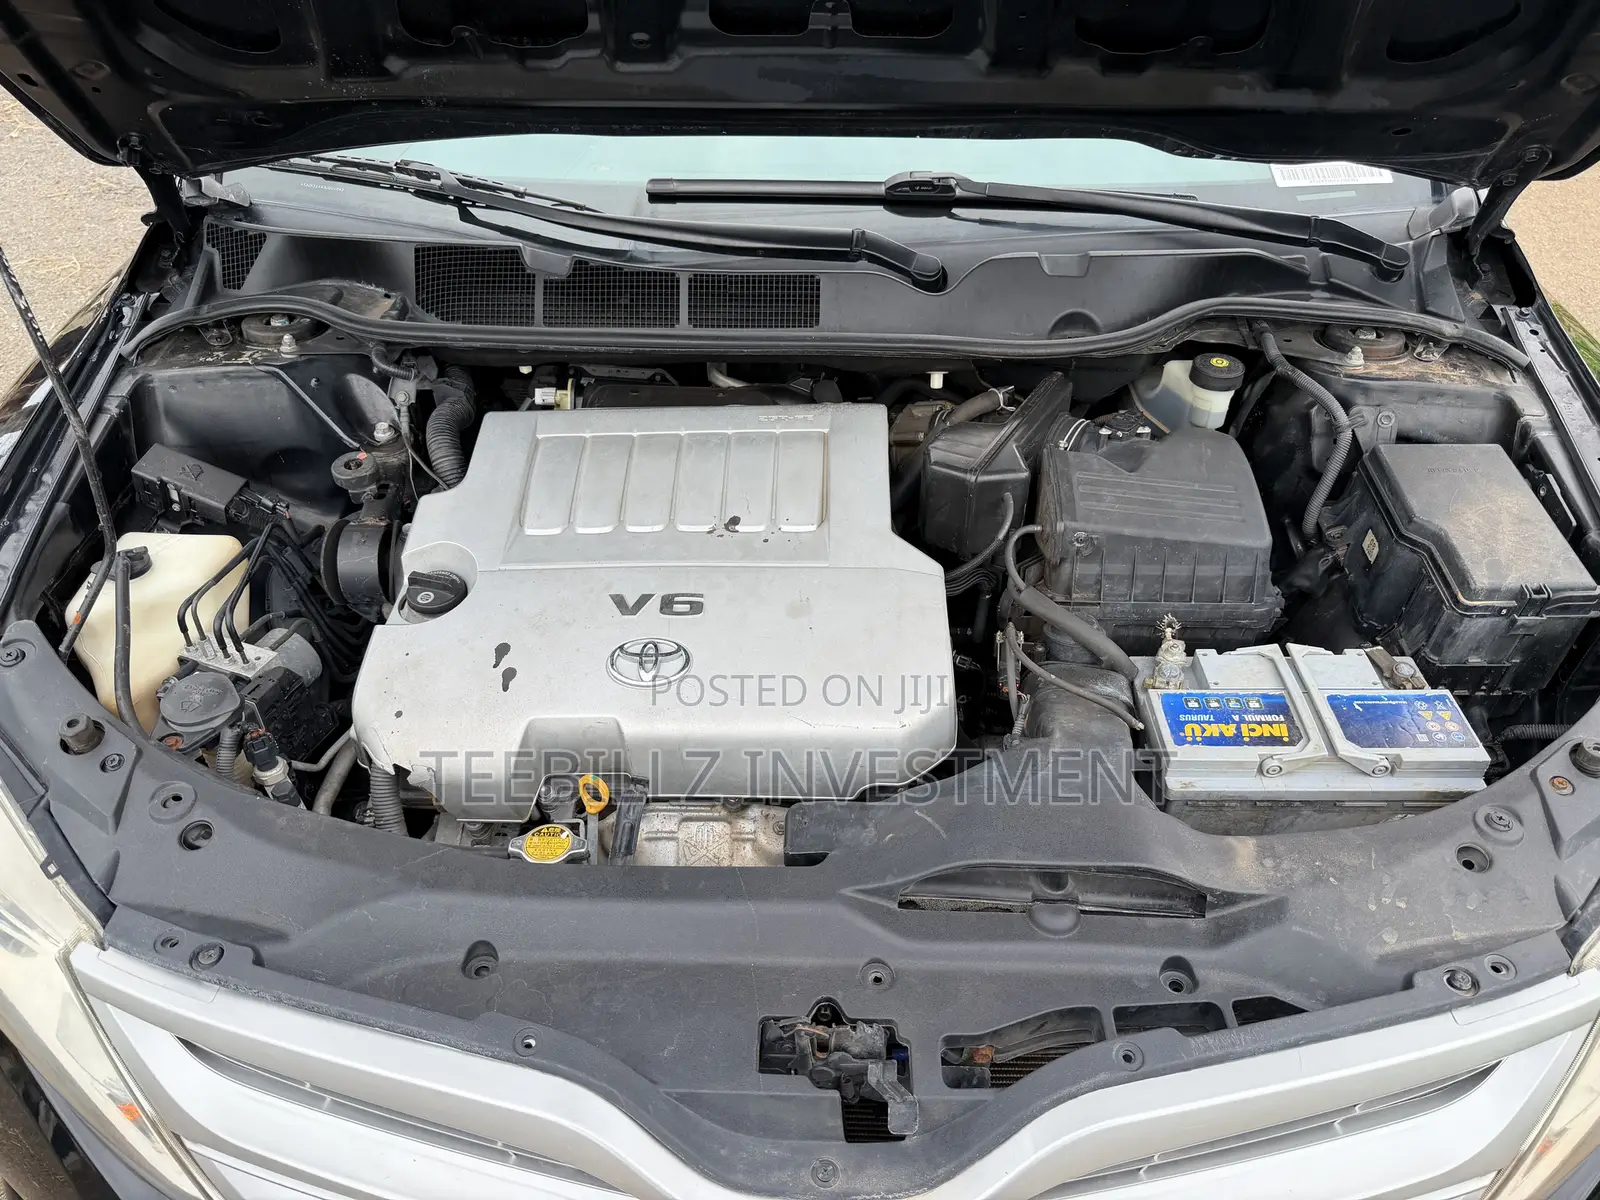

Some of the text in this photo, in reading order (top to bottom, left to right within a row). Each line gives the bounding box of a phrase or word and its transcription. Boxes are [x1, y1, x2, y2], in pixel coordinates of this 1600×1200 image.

[608, 593, 704, 616] V6
[1179, 714, 1285, 722] FORMUL A TAURUS
